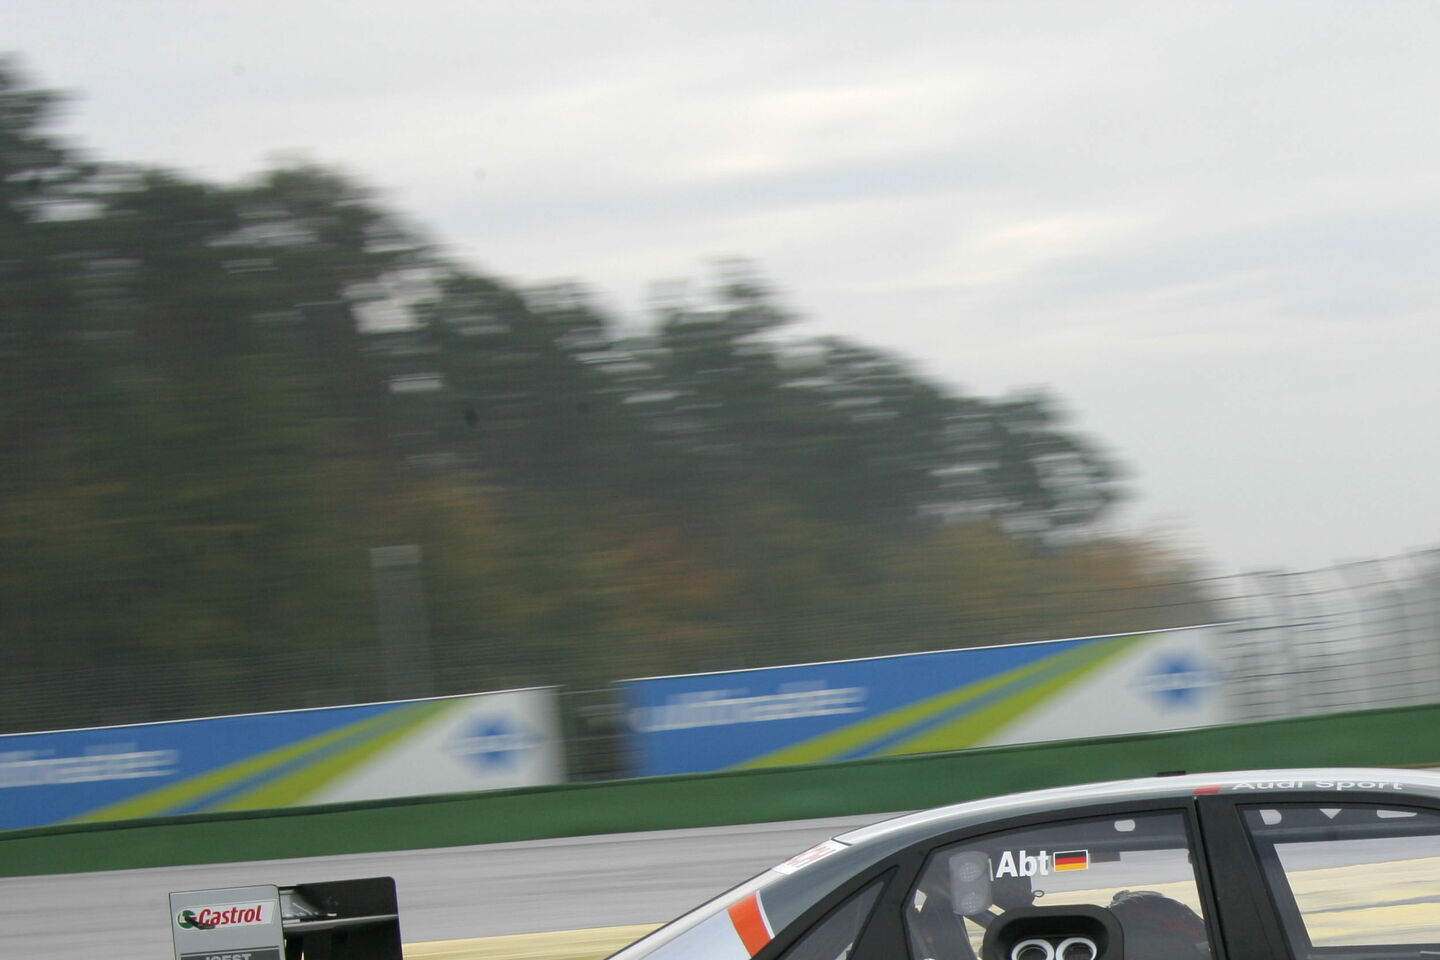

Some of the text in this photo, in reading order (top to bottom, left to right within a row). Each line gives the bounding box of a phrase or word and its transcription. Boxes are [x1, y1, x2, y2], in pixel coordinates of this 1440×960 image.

[1232, 779, 1402, 791] Audi Sport
[996, 851, 1048, 878] Abt
[199, 905, 262, 926] Castrol
